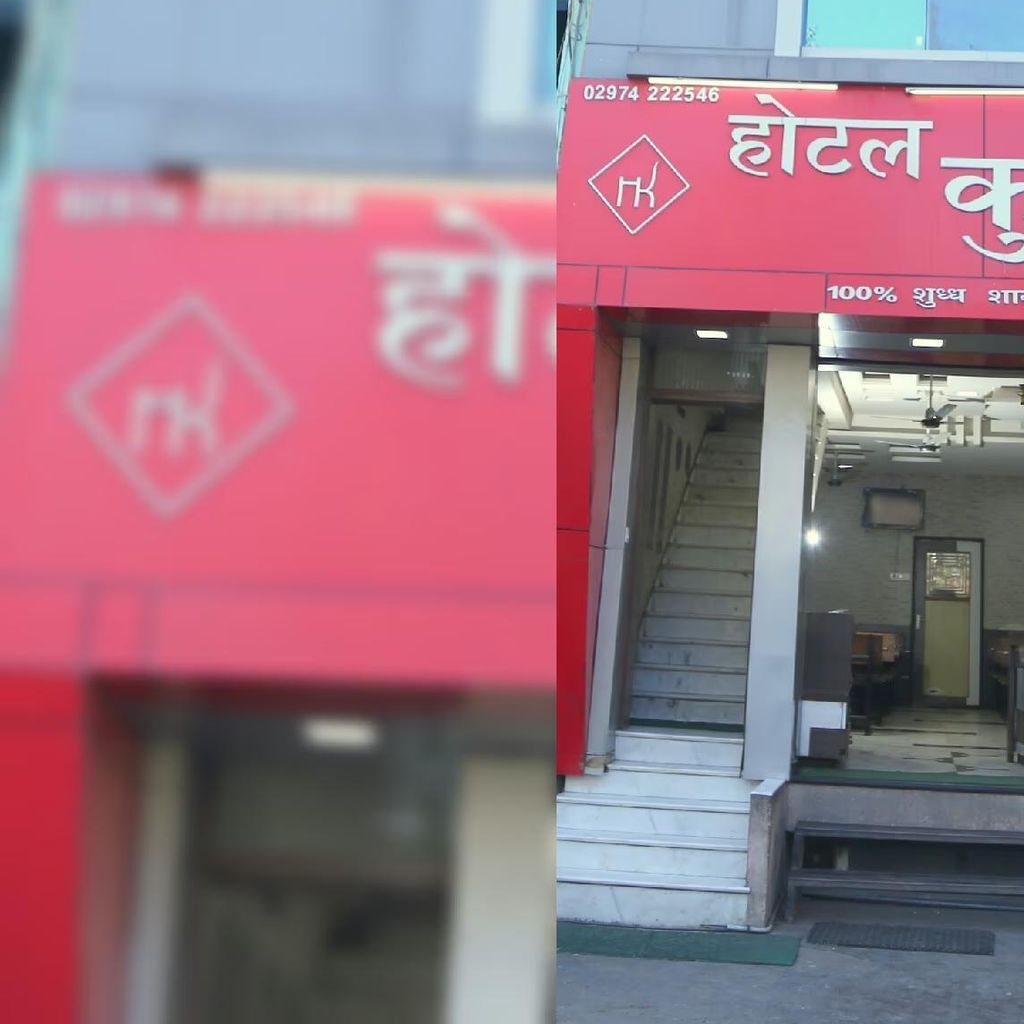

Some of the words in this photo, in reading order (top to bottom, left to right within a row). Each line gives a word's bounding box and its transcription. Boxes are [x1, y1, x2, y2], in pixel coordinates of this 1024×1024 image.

[583, 84, 640, 102] 02974
[647, 85, 721, 104] 222546
[727, 93, 934, 180] होटल
[827, 284, 898, 303] 100%
[911, 286, 968, 308] शुध्ध
